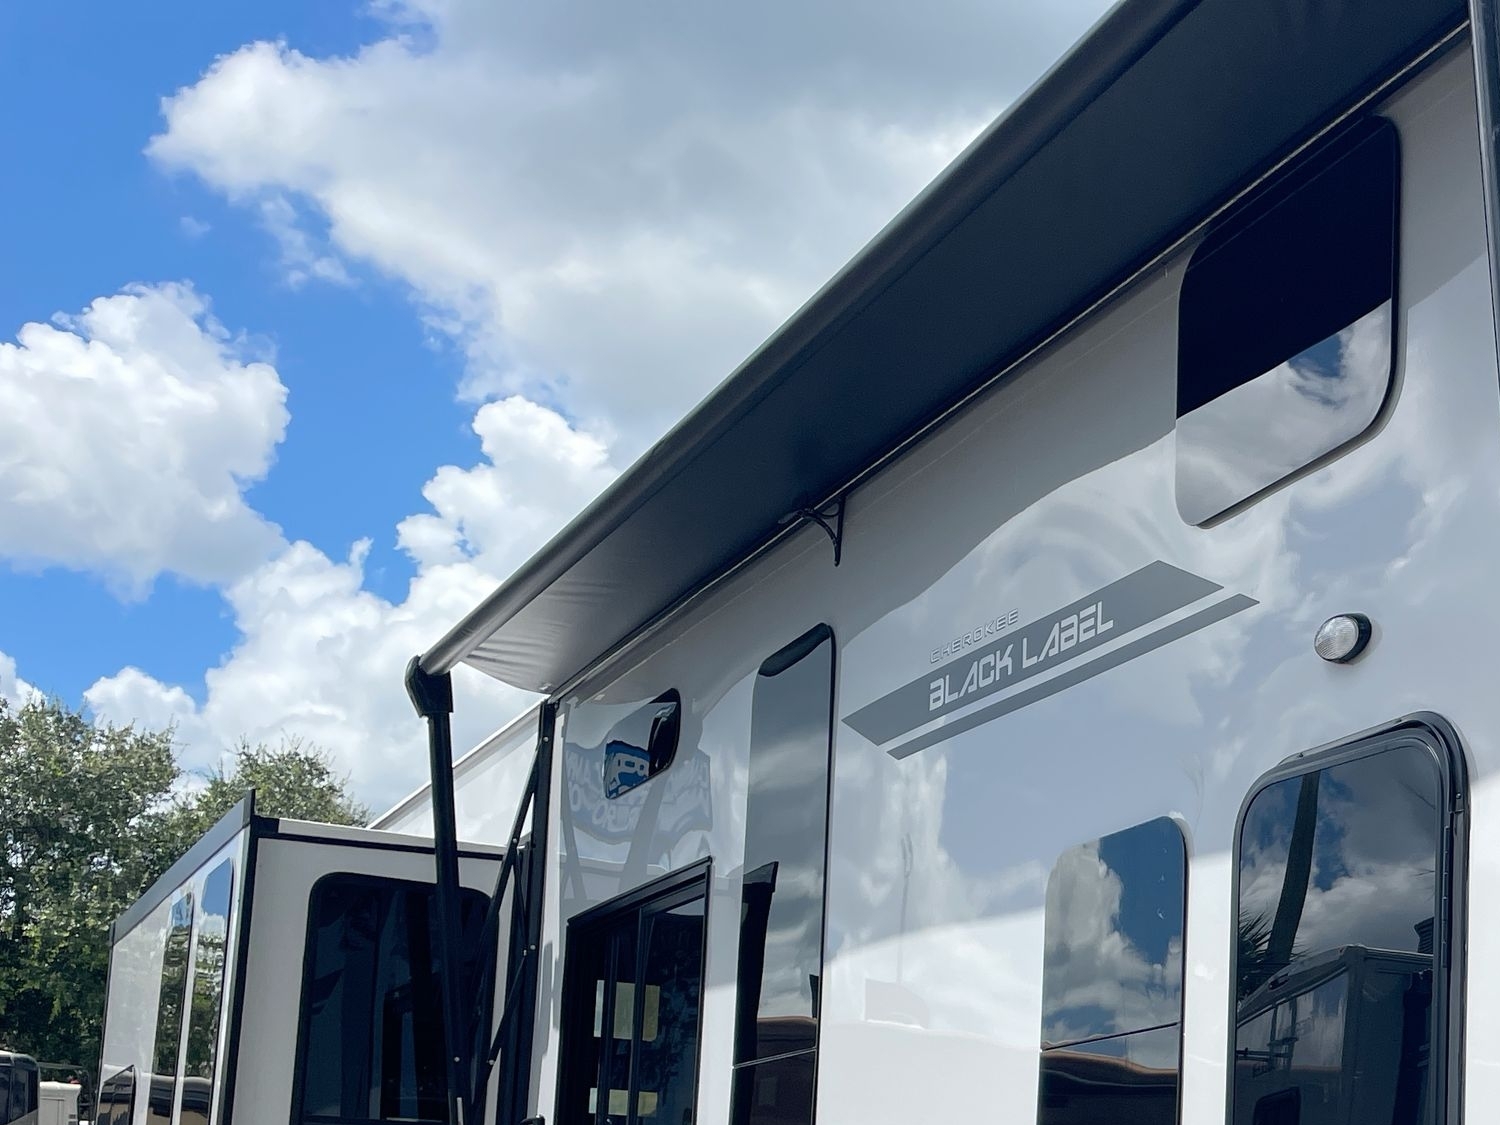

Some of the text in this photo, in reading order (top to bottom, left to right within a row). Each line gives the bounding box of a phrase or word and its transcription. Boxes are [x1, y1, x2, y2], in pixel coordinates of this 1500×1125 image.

[928, 607, 1020, 664] CHEROKEE
[928, 600, 1115, 712] BLACK LABEL
